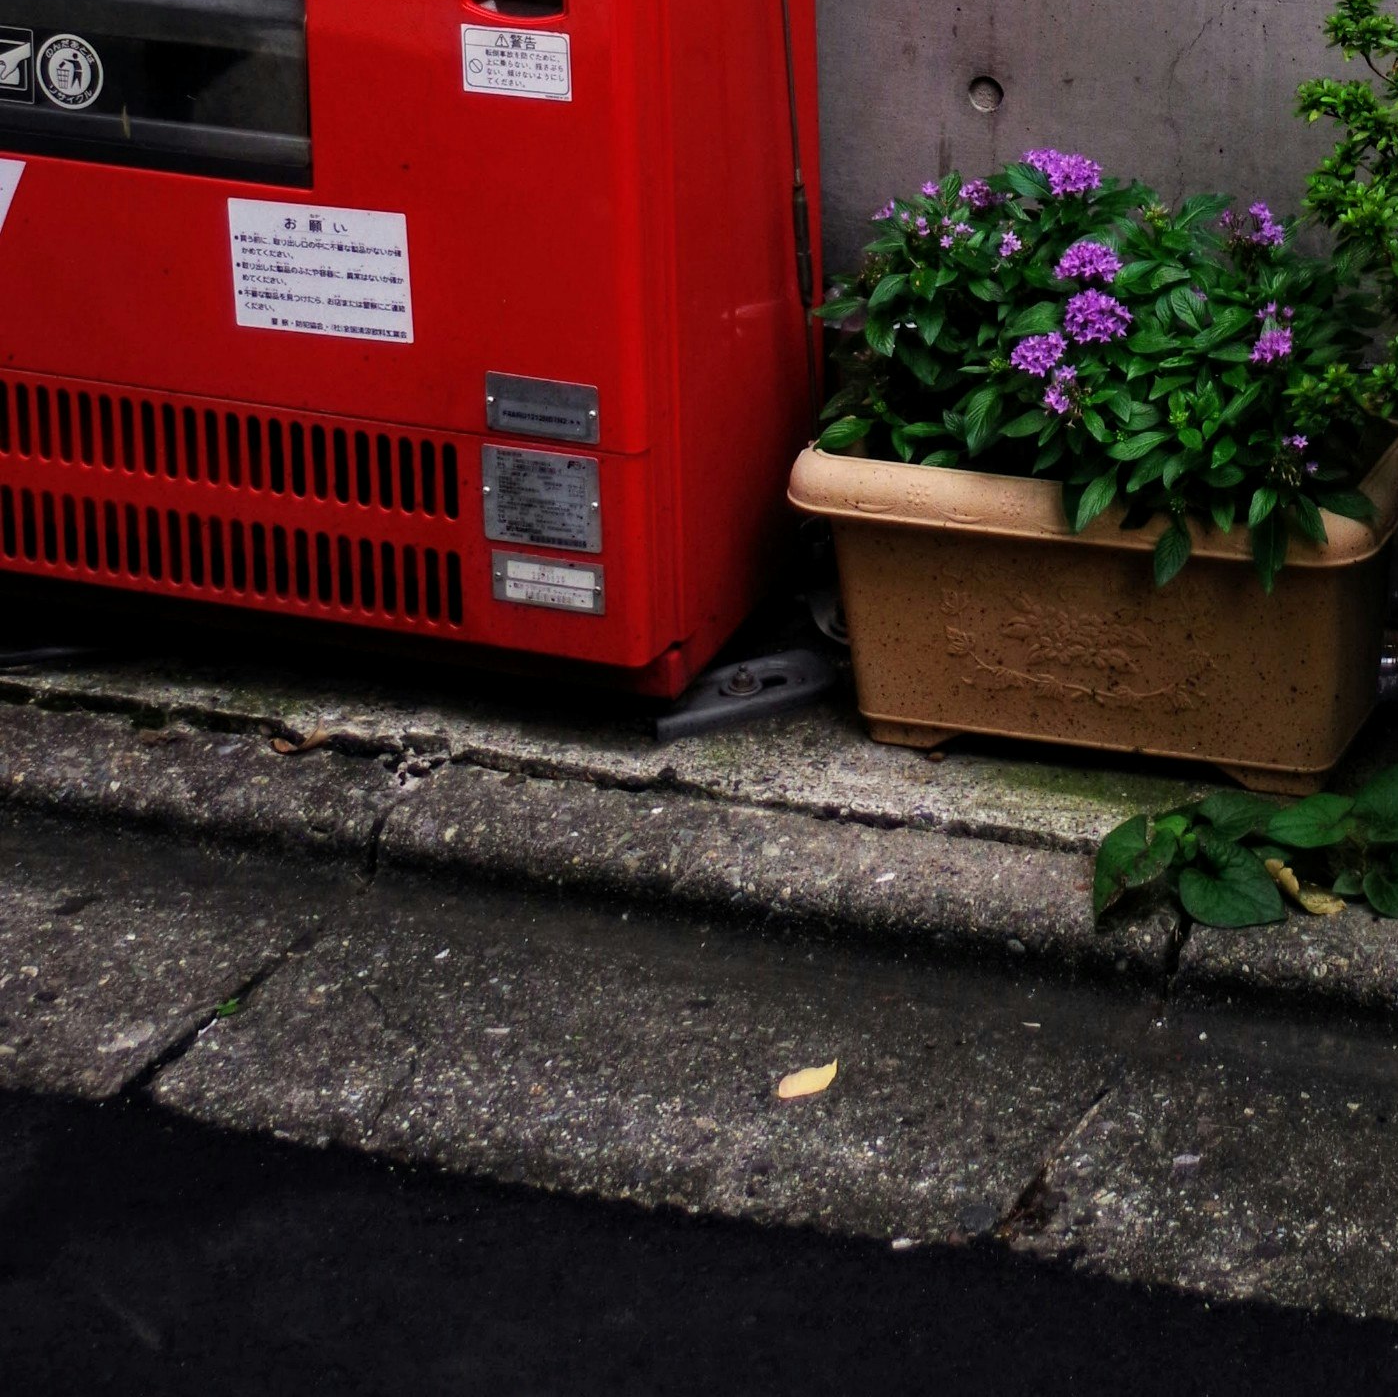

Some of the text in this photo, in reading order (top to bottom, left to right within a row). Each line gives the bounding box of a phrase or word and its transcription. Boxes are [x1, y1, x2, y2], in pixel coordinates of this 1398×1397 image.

[509, 33, 537, 50] 警告
[45, 38, 96, 64] のんだあとは
[487, 77, 527, 88] てください。
[48, 84, 93, 104] リサイクル
[284, 217, 349, 234] お願い
[241, 246, 294, 260] かめてください。
[242, 273, 287, 286] めてください。
[245, 302, 276, 312] ください。
